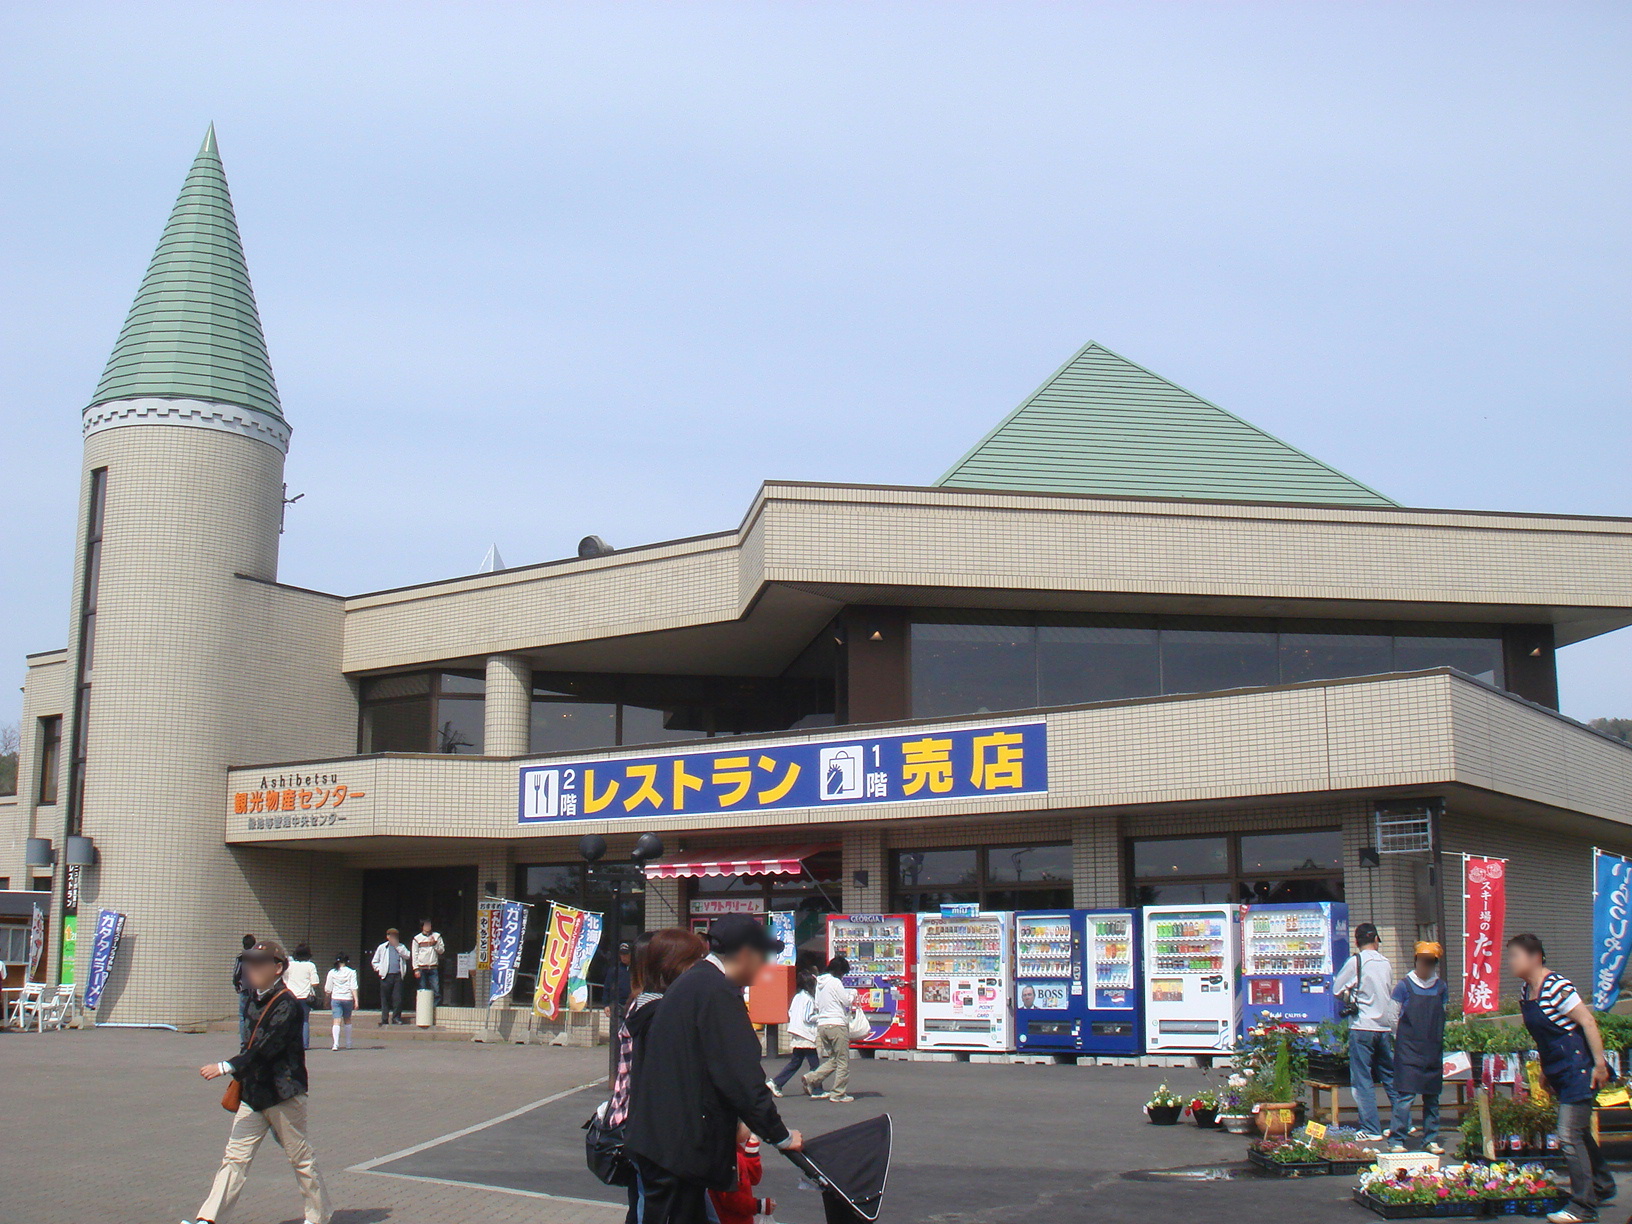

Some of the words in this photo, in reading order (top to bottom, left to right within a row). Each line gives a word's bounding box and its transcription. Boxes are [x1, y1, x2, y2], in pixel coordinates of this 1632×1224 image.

[866, 744, 888, 798] 1階
[902, 732, 1024, 796] 売店
[261, 773, 338, 789] Ashibetsu
[560, 768, 577, 817] 2階
[584, 755, 802, 814] レストラン
[234, 785, 366, 814] 観光物産センター
[703, 900, 754, 912] ソフトクリーム
[951, 907, 968, 915] miu
[585, 916, 600, 956] 北海道
[1468, 881, 1493, 1010] スキー場のたい焼
[1038, 989, 1064, 999] BOSS
